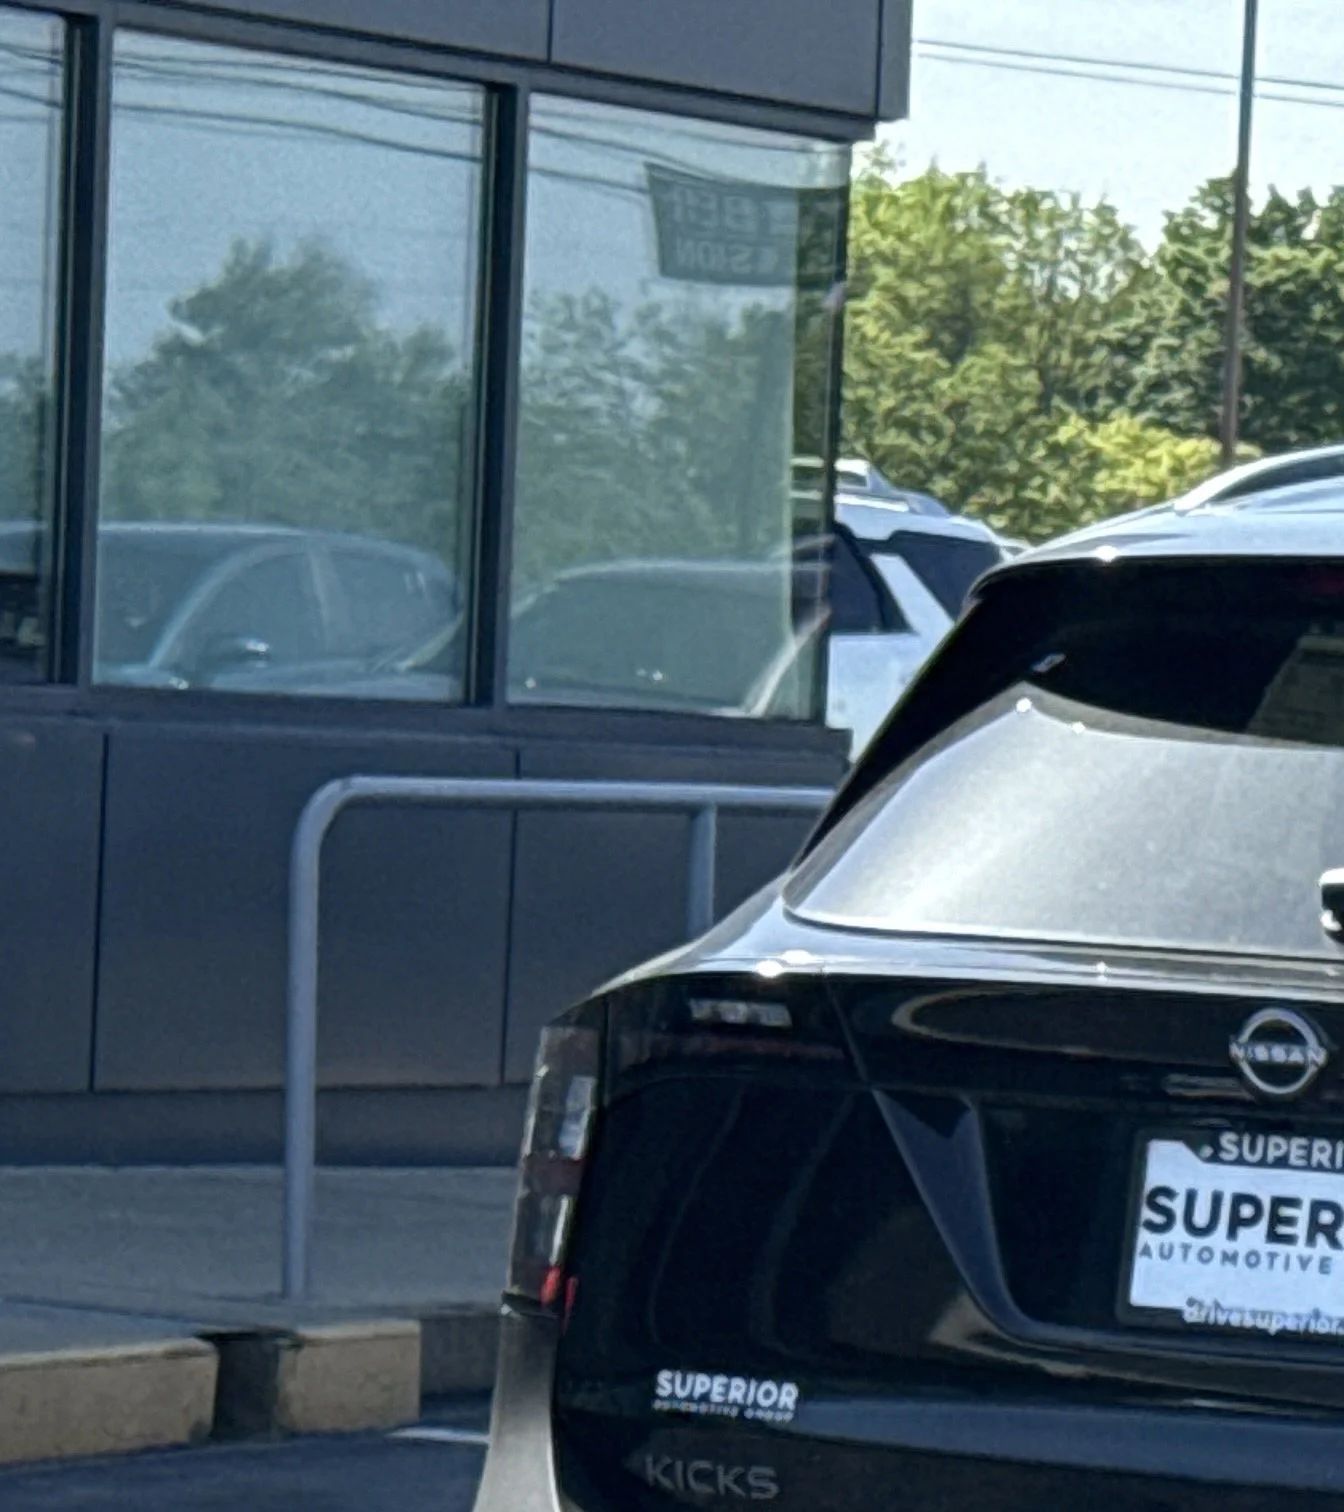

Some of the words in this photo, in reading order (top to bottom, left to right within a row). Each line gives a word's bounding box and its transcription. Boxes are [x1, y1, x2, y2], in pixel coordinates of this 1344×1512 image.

[1229, 1042, 1328, 1067] NISSAN
[1138, 1242, 1334, 1276] AUTOMOTIVE
[655, 1369, 799, 1411] SUPERIOR
[645, 1454, 780, 1500] KICKS
